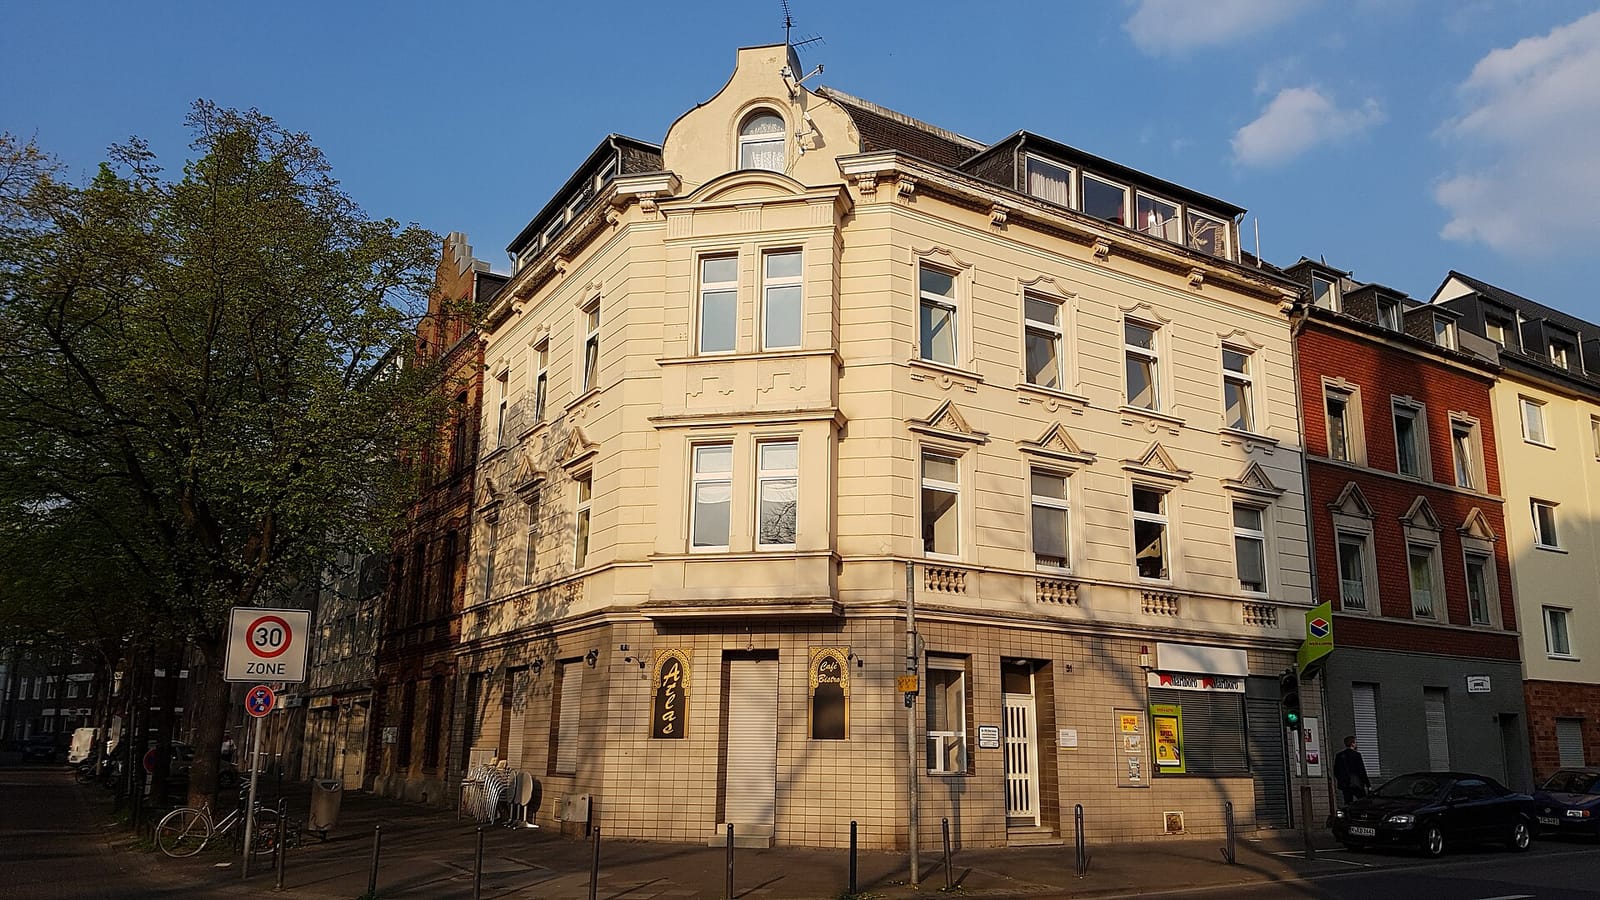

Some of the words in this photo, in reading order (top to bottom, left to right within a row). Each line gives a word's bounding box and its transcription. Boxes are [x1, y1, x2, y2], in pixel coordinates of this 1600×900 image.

[255, 627, 282, 647] 30
[246, 662, 286, 675] ZONE
[820, 661, 838, 672] Café
[818, 673, 841, 683] Bistro
[661, 662, 681, 734] Atlas
